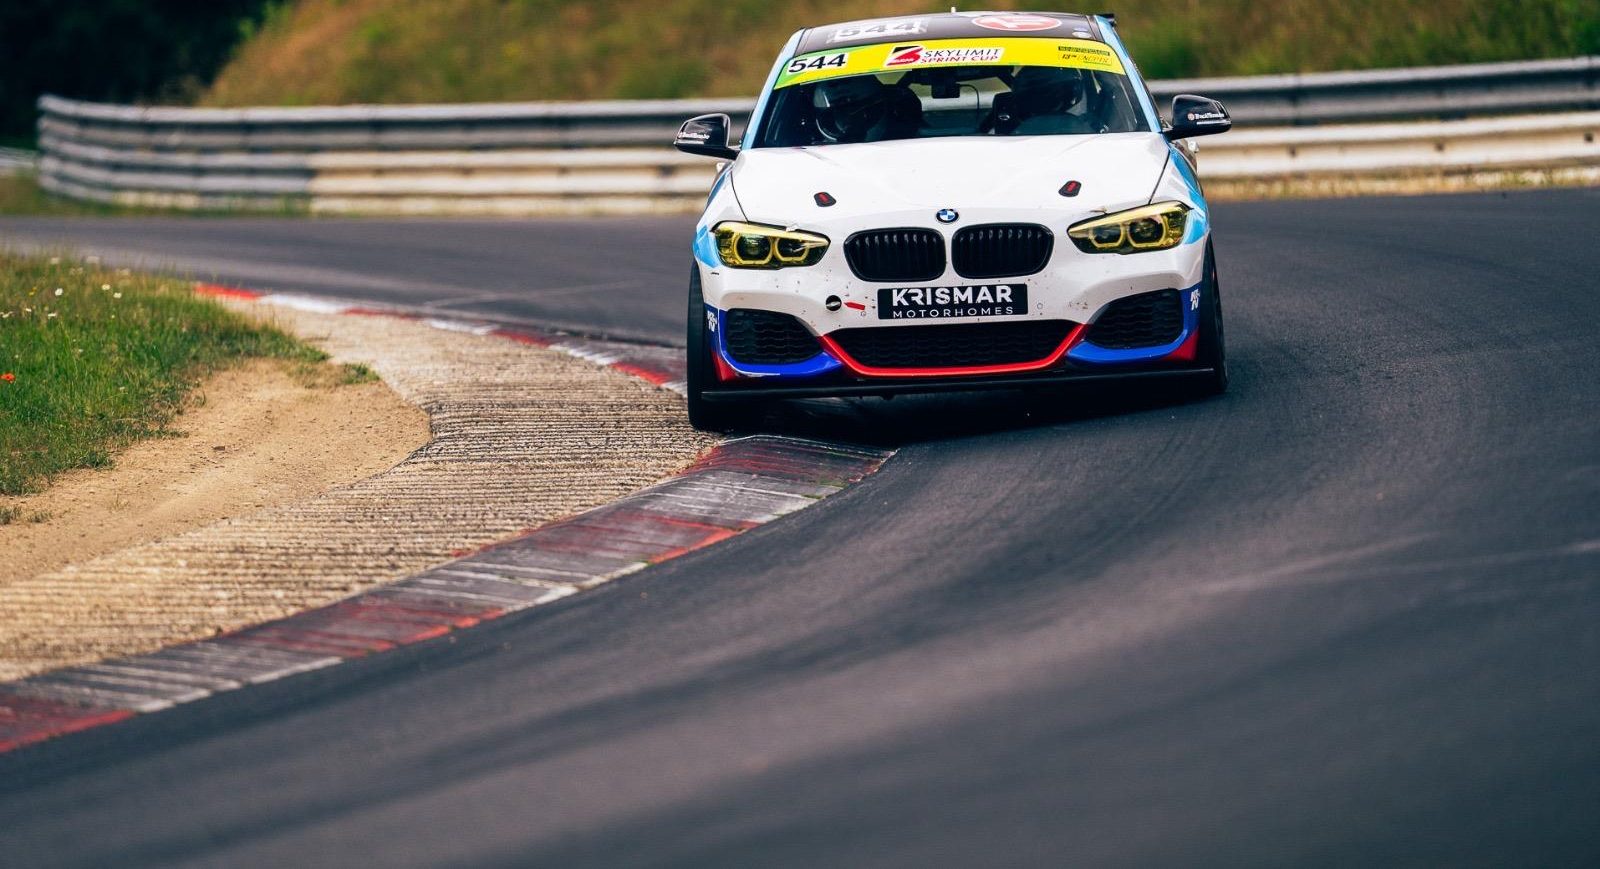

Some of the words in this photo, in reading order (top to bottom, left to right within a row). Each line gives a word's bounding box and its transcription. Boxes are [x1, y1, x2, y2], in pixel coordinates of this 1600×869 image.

[836, 20, 916, 38] 544
[921, 56, 967, 64] SPRINT
[924, 48, 1001, 58] SKYLIMIT
[788, 53, 847, 73] 544
[892, 285, 1013, 307] KRISMAR
[893, 306, 1014, 319] MOTORHOMES
